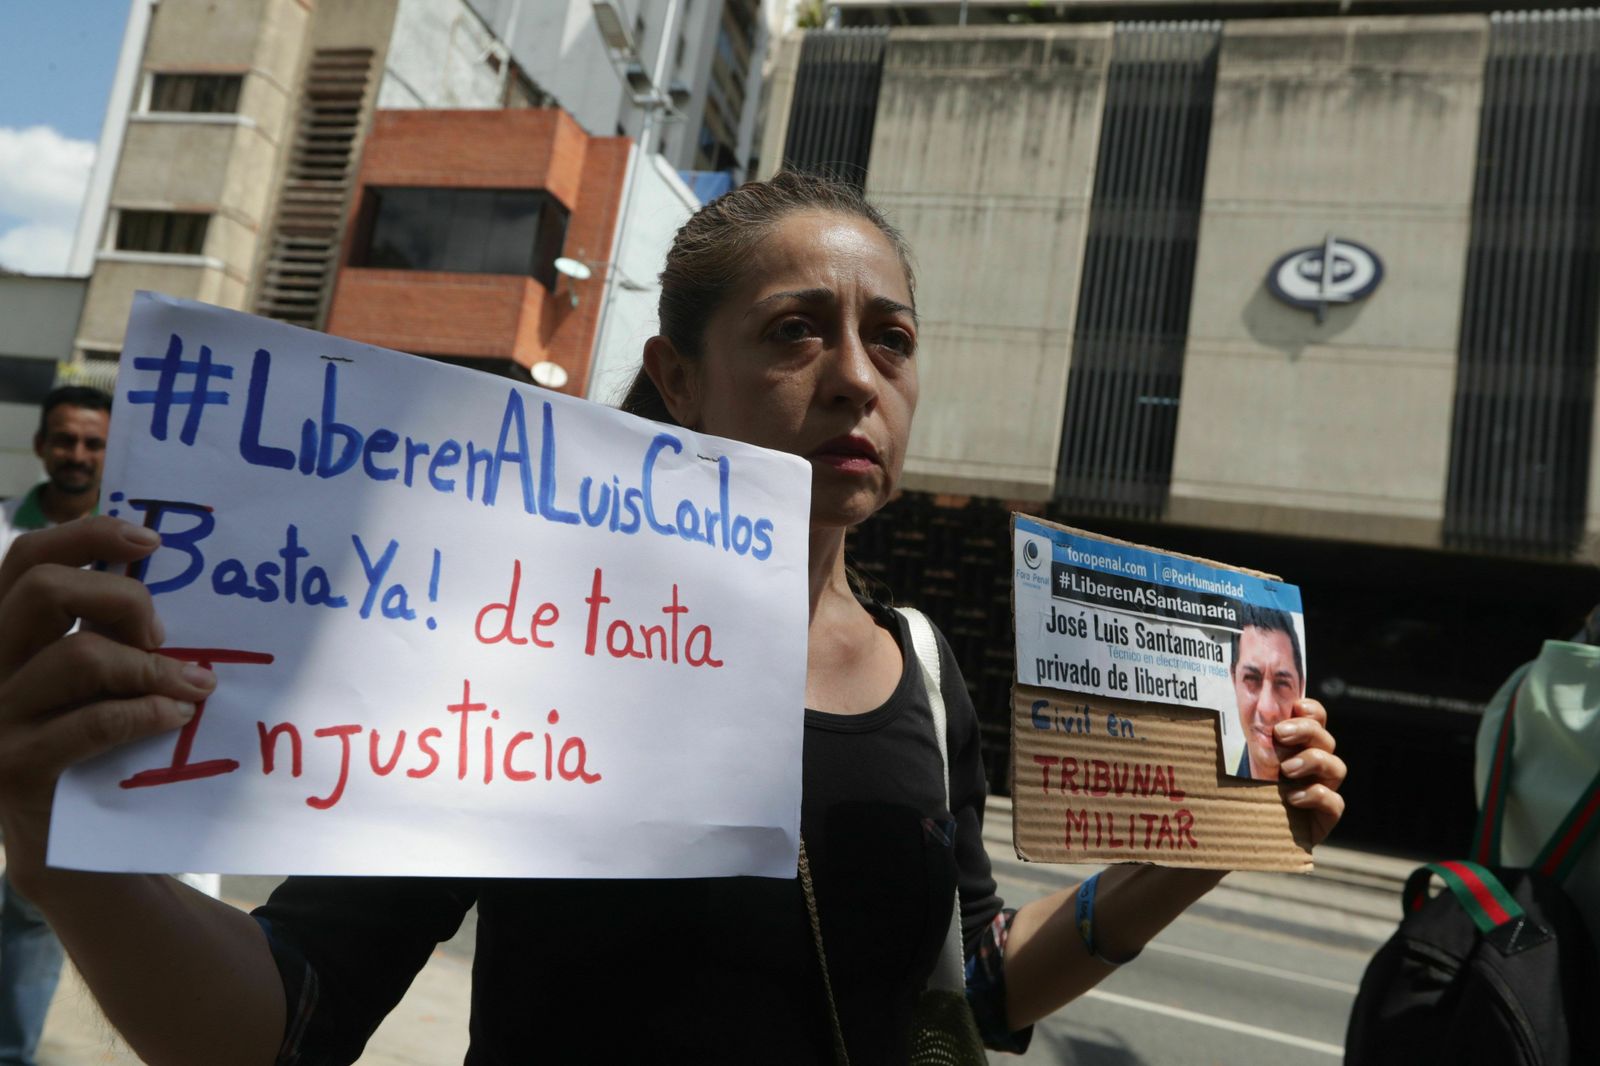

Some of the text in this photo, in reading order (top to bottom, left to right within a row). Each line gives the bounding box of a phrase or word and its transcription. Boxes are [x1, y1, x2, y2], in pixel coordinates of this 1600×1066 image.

[1059, 571, 1237, 622] #LiberenASantamaría
[1067, 547, 1147, 578] foropenal.com
[1162, 567, 1244, 598] @PorHumanidad
[352, 534, 440, 630] Ya!
[475, 559, 559, 648] de
[585, 567, 724, 668] tanta
[1046, 606, 1224, 663] José Luis Santamaría
[1036, 654, 1198, 701] privado de libertad
[1031, 700, 1091, 736] Civil
[1033, 755, 1186, 803] TRIBUNAL
[1065, 808, 1199, 851] MILITAR
